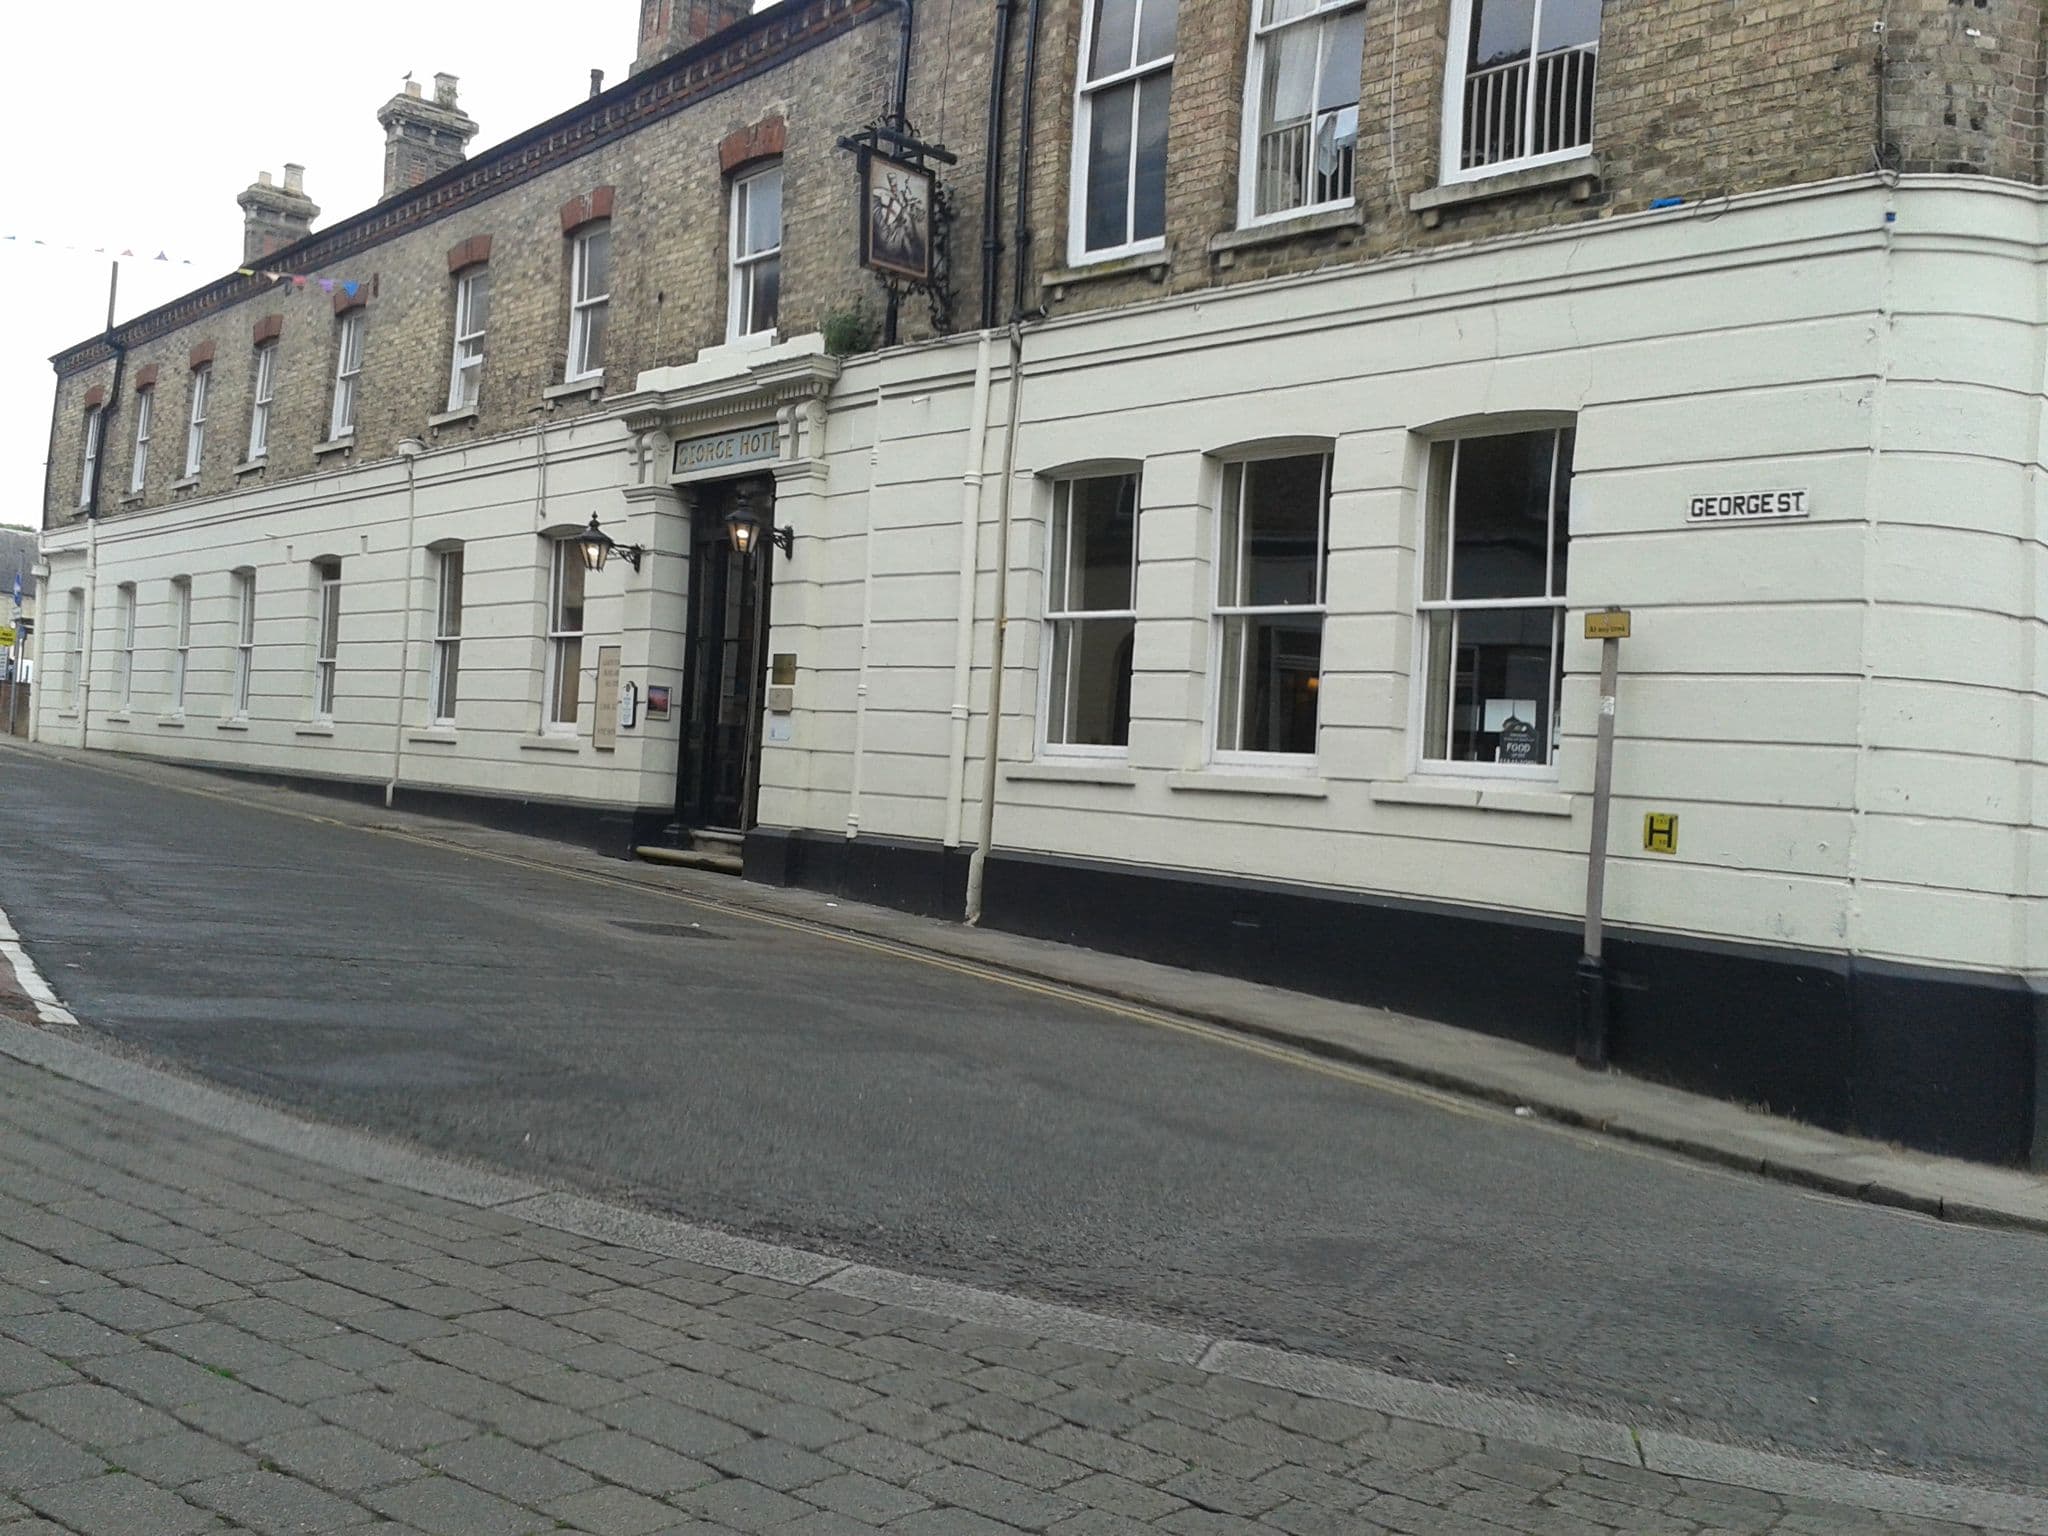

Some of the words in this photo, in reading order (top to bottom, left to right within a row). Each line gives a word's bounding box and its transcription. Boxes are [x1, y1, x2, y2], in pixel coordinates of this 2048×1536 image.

[678, 438, 735, 466] GEORGE
[739, 430, 780, 457] HOTE
[1691, 493, 1774, 517] GEORGE
[1777, 491, 1805, 513] ST
[1506, 742, 1531, 753] FOOD
[1648, 815, 1673, 848] H
